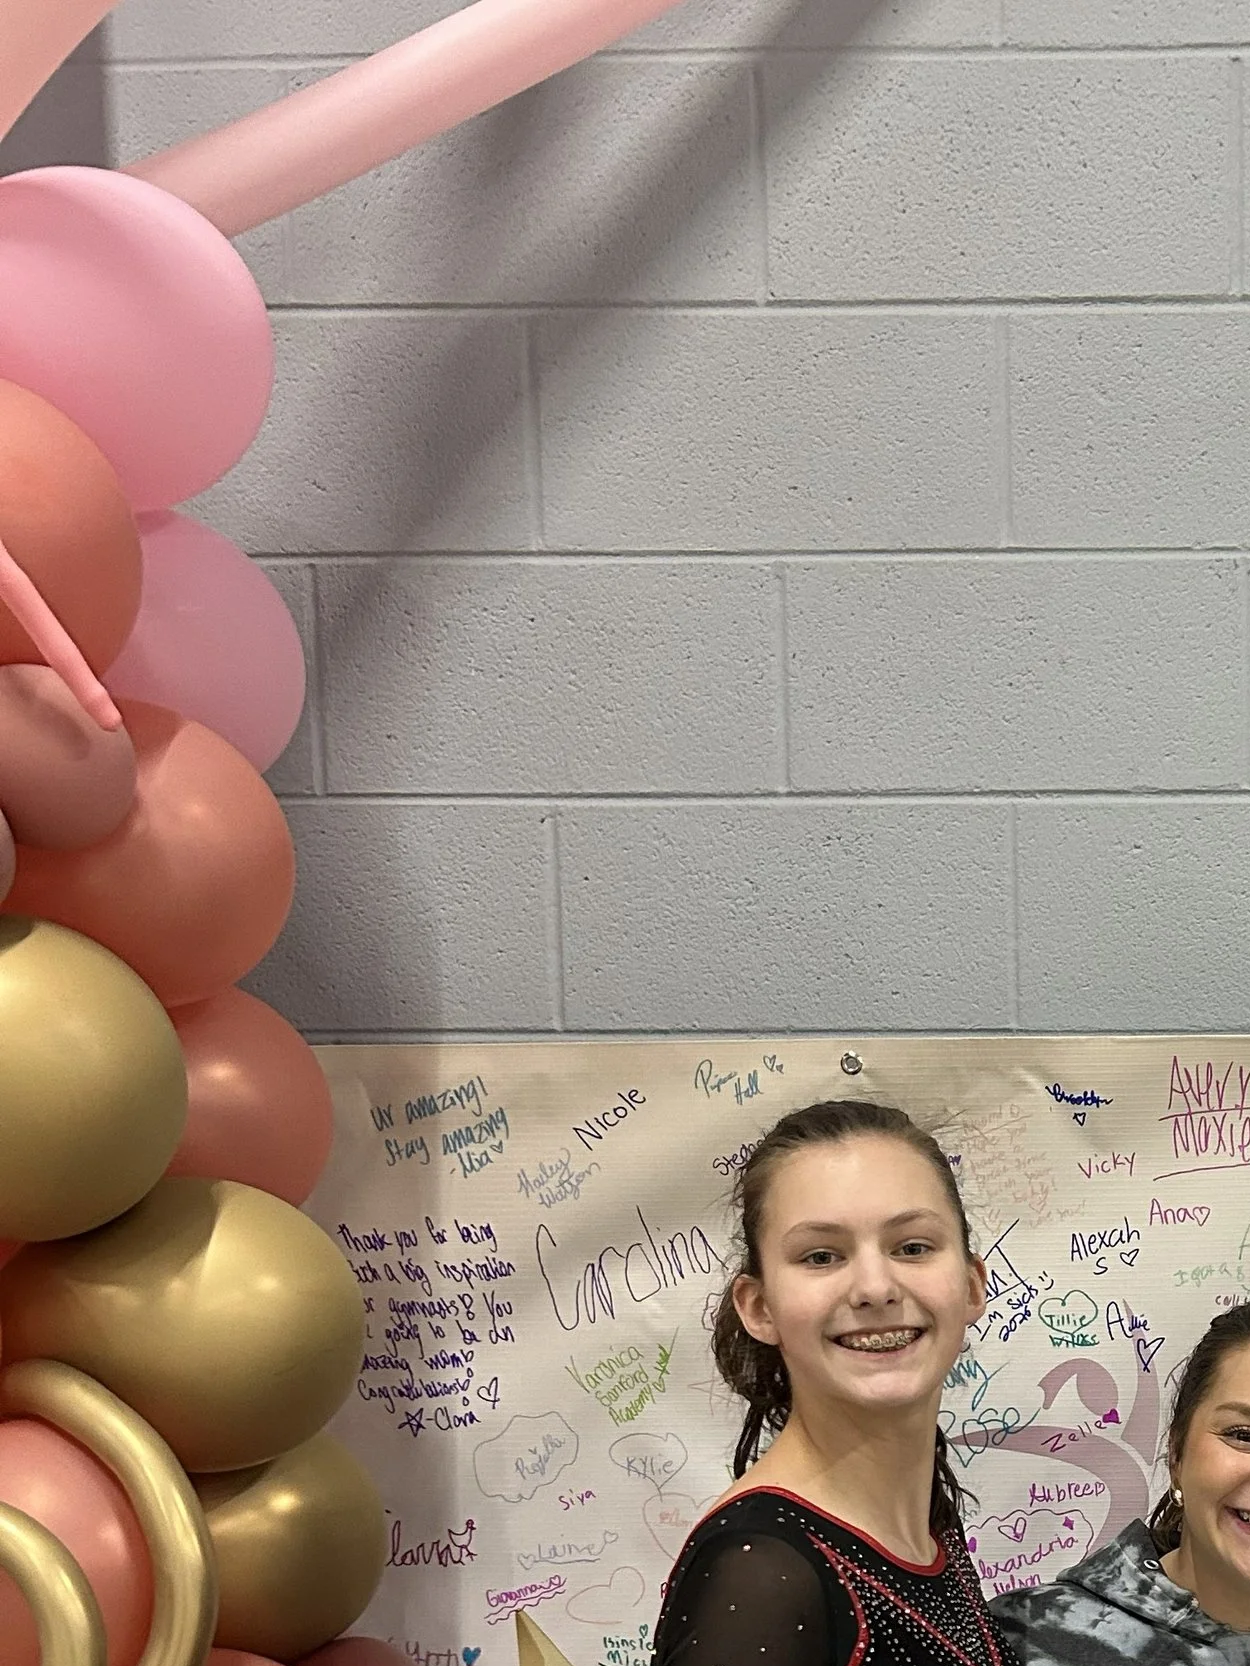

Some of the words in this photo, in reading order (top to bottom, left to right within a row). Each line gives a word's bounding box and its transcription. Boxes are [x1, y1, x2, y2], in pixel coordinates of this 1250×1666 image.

[734, 1069, 764, 1106] Hall
[572, 1086, 647, 1151] Nicole
[1149, 1198, 1192, 1226] Ana
[395, 1229, 418, 1255] you
[1093, 1257, 1108, 1275] S
